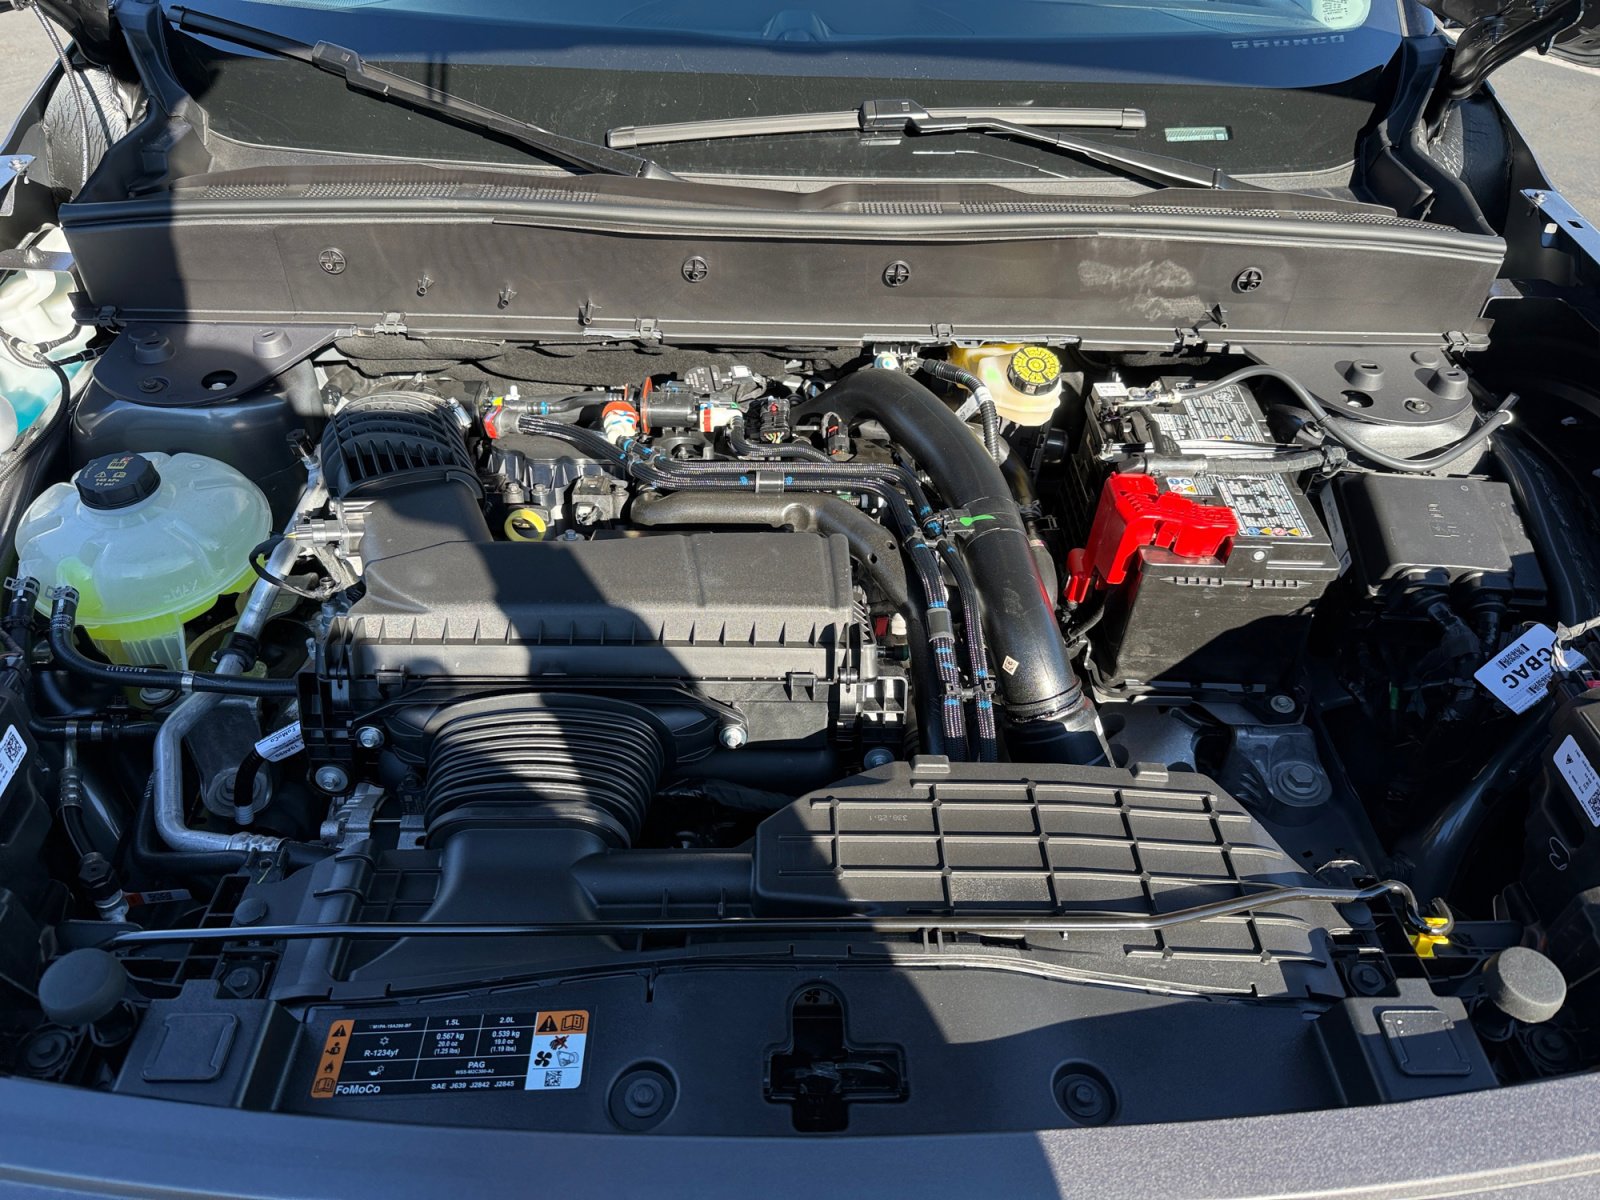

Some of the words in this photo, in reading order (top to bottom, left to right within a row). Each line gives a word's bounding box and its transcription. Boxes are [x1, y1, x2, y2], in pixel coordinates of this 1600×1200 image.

[445, 1018, 460, 1026] 1.5L
[499, 1016, 515, 1024] 2.0L
[456, 1032, 464, 1040] kg
[511, 1030, 520, 1038] kg
[363, 1048, 399, 1058] R-1234yf
[449, 1047, 460, 1055] lbs)
[505, 1045, 517, 1053] lbs)
[467, 1061, 486, 1069] PAG
[431, 1082, 446, 1090] SAE
[449, 1081, 467, 1089] J639
[469, 1080, 490, 1088] J2842
[494, 1079, 515, 1088] J2845
[335, 1084, 381, 1095] FoMoCo
